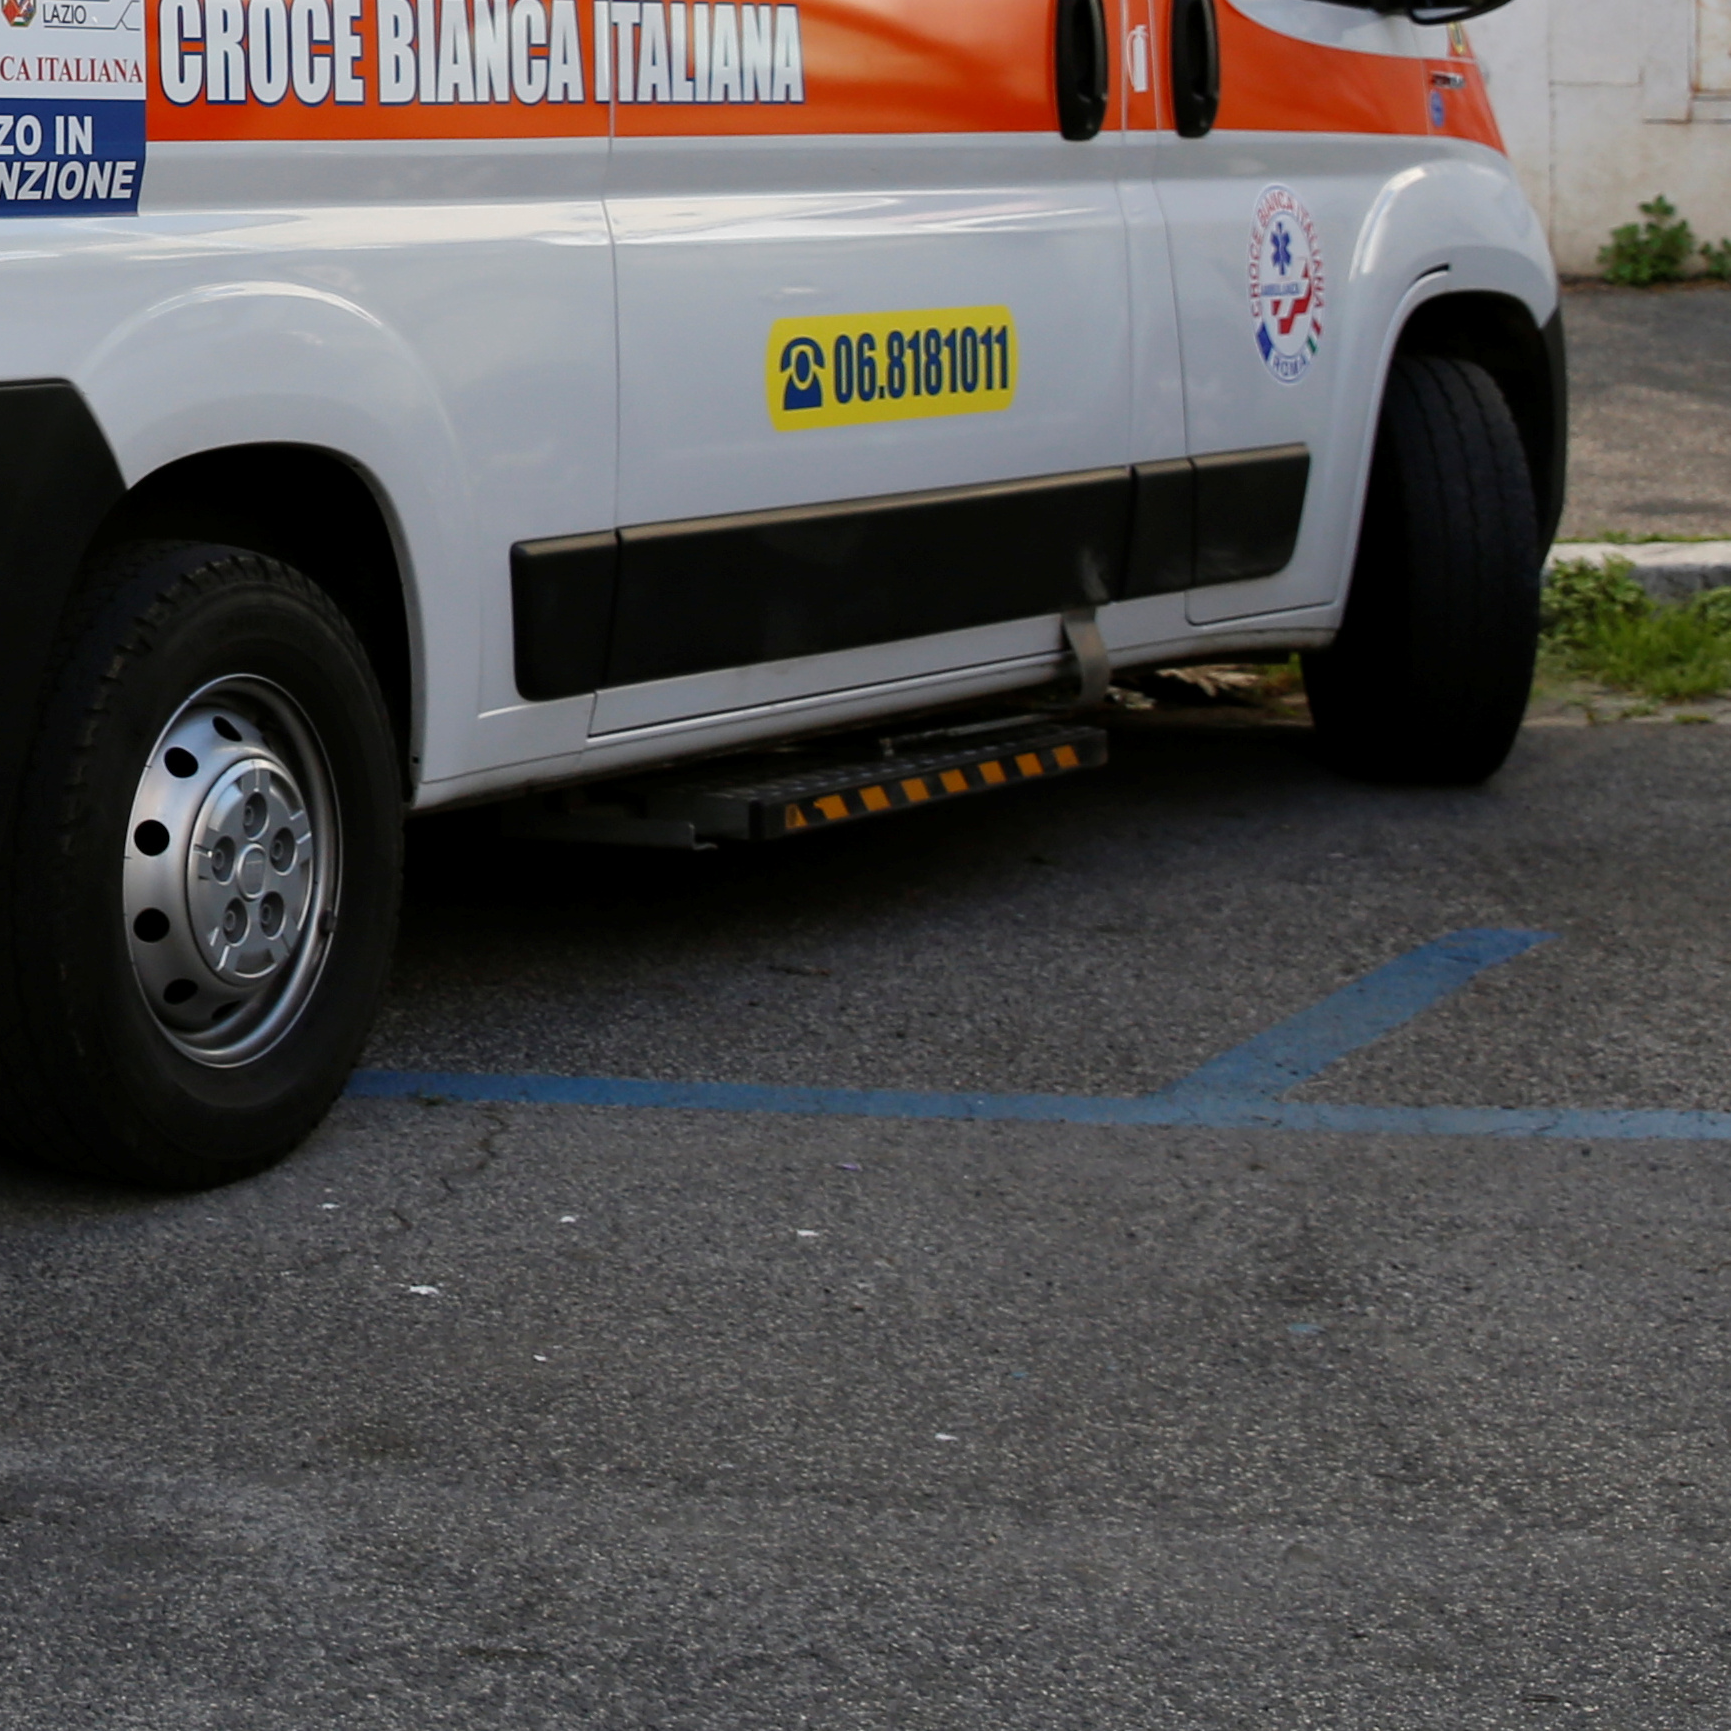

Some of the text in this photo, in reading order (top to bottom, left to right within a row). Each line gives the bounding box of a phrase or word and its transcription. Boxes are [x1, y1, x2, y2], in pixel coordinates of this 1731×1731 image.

[43, 4, 87, 24] LAZIO
[37, 57, 144, 83] ITALIANA
[55, 115, 93, 155] IN
[834, 325, 1008, 404] 06.8181011
